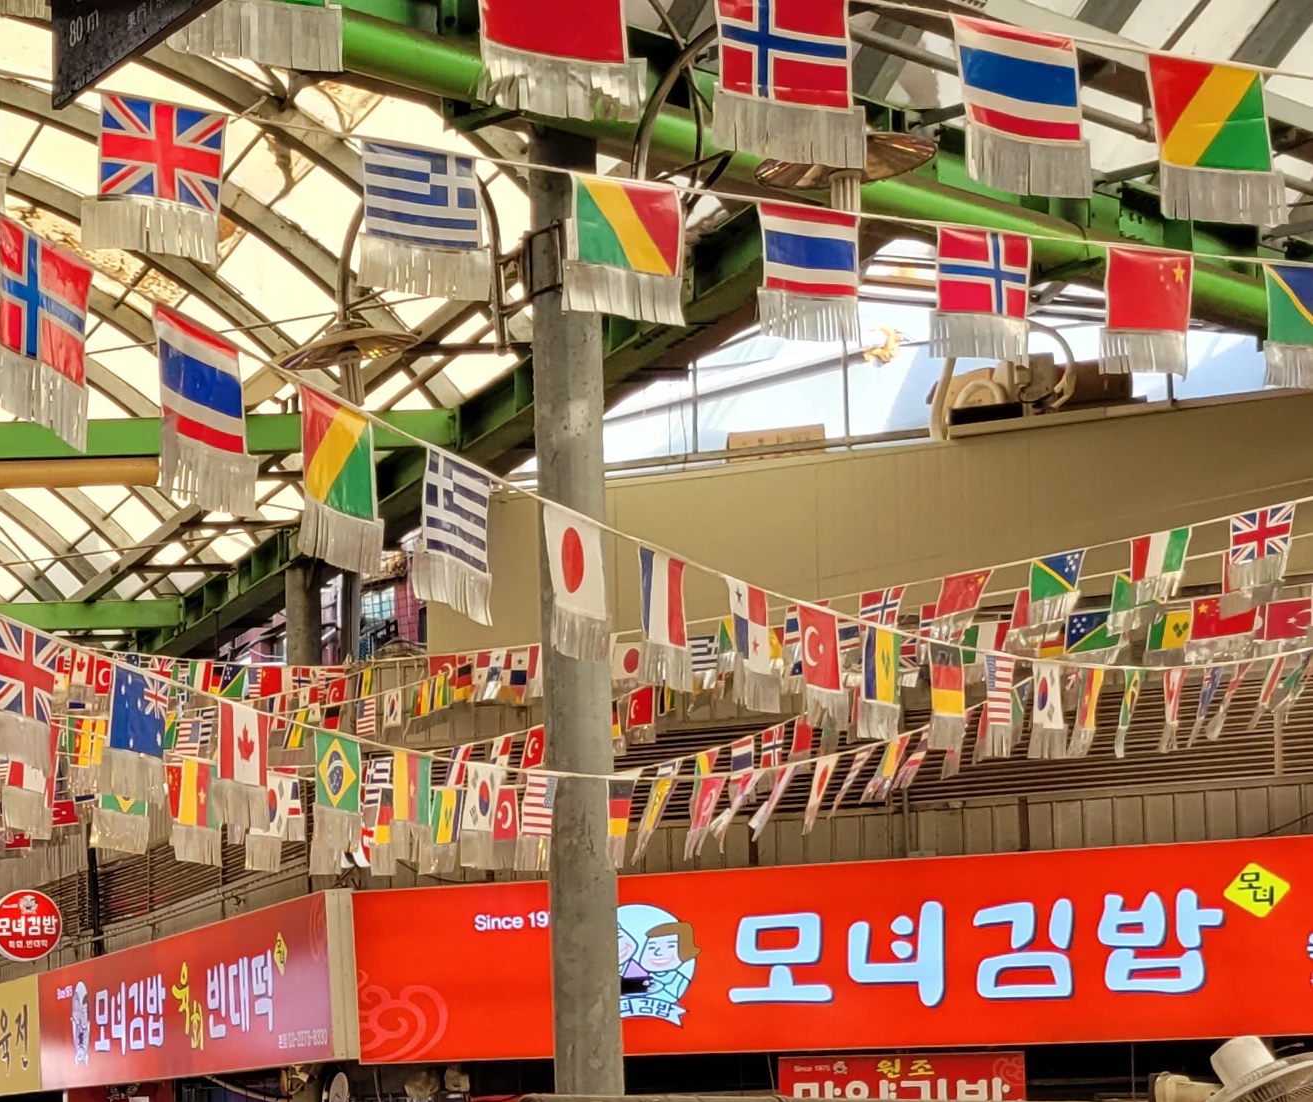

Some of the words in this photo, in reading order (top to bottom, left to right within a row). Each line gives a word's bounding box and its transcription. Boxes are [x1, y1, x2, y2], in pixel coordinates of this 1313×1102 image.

[1236, 870, 1276, 908] 모녀
[474, 914, 525, 932] Since
[527, 912, 550, 929] 19
[727, 888, 1228, 1008] 모녀김밥
[93, 972, 166, 1055] 모녀김밥
[207, 948, 274, 1039] 빈대떡
[638, 998, 676, 1018] 김밥
[793, 1064, 813, 1073] Since
[876, 1058, 935, 1079] 원조
